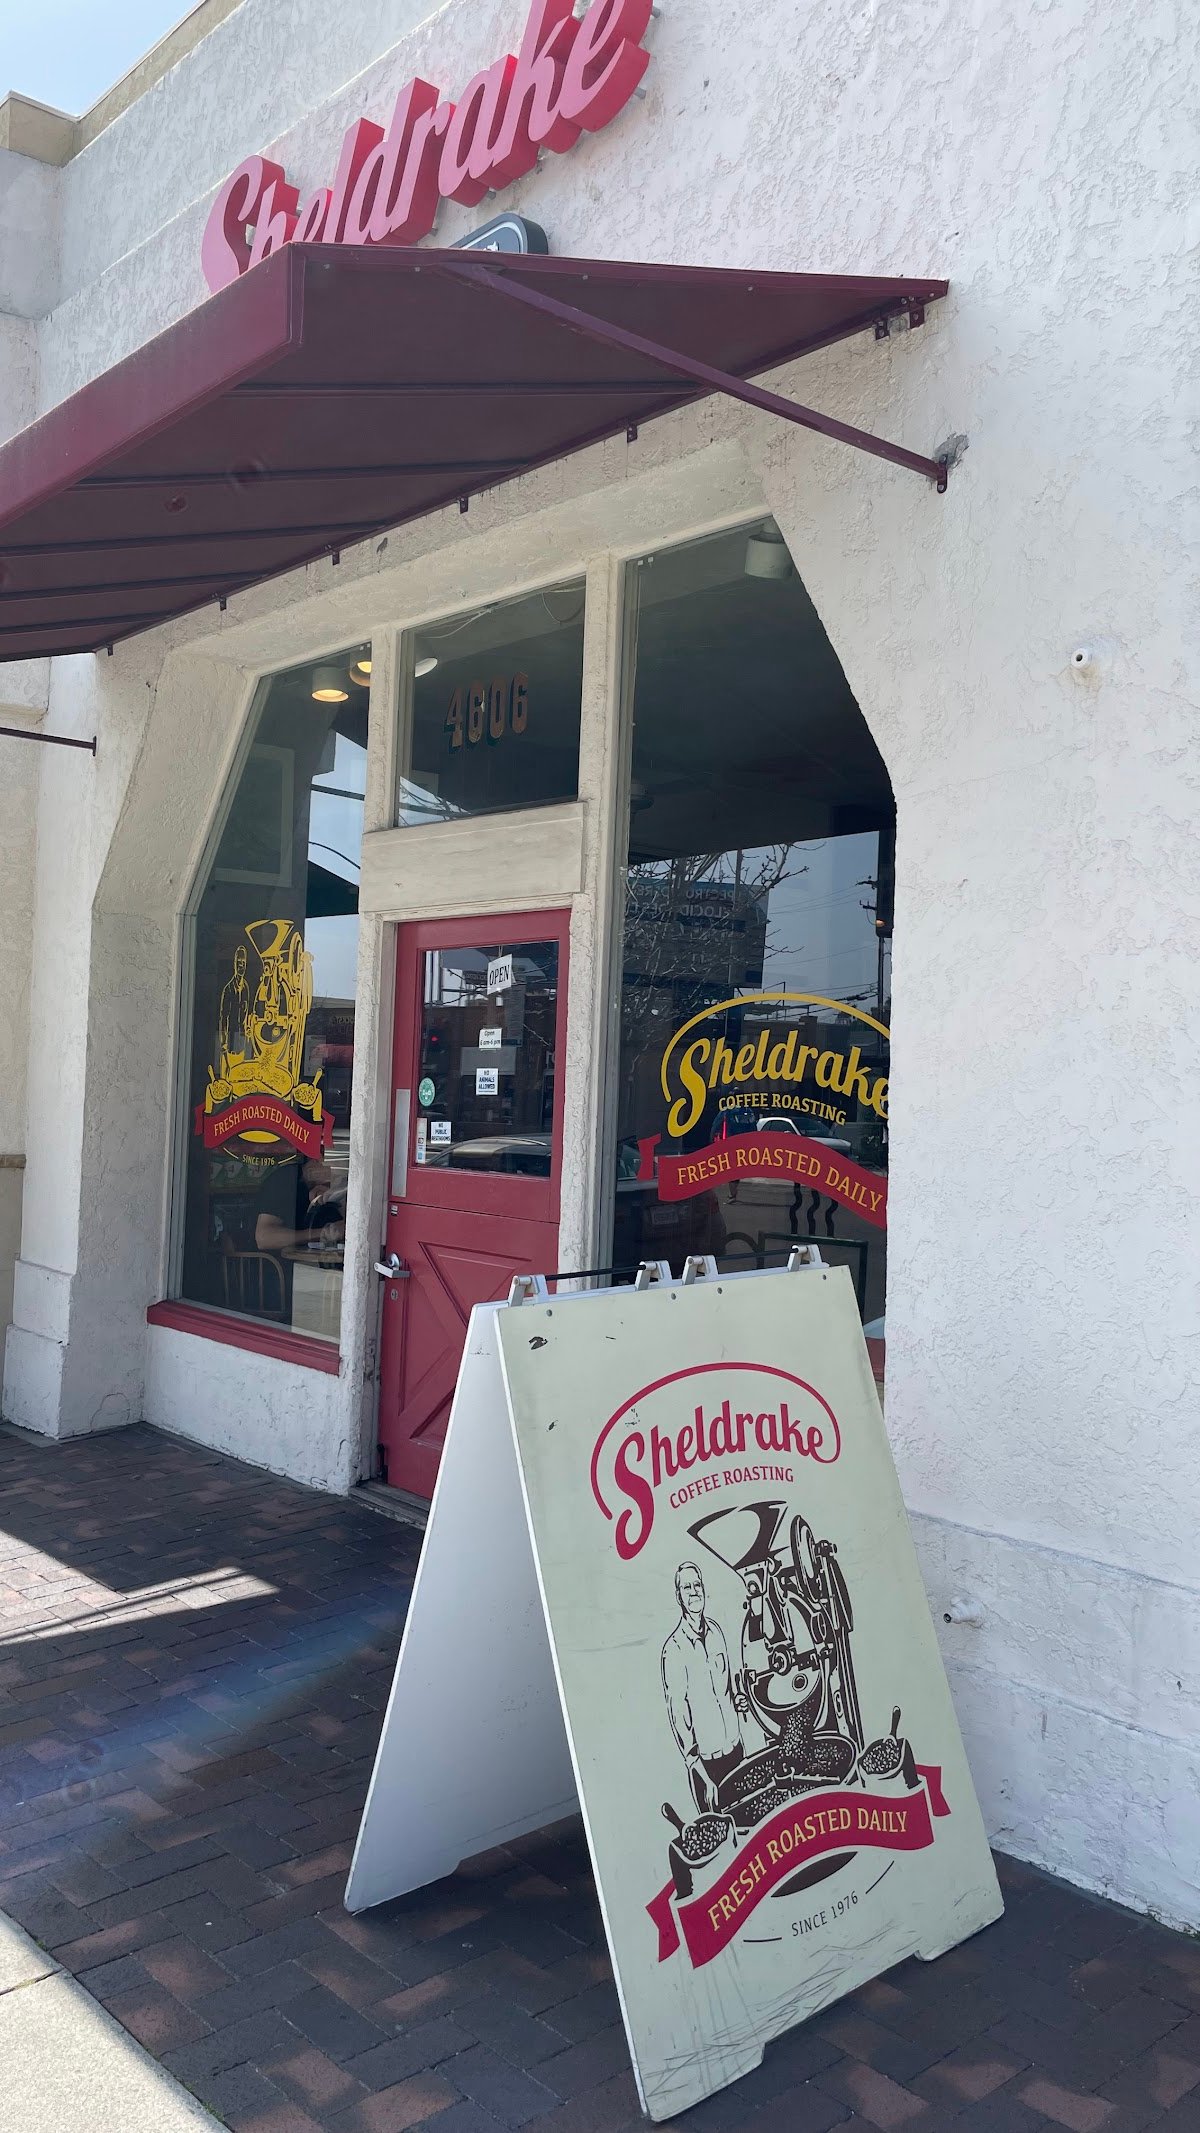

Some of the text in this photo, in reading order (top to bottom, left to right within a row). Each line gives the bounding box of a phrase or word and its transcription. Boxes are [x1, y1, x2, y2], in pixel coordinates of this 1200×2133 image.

[444, 671, 529, 752] 4606
[488, 964, 511, 987] OPEN
[667, 1028, 889, 1138] Sheldrake
[214, 1105, 310, 1144] FRESH ROASTED DAILY
[718, 1092, 847, 1127] COFFEE ROASTING
[242, 1153, 275, 1167] SINCE 1976
[677, 1147, 884, 1213] FRESH ROASTED DAILY
[613, 1399, 824, 1561] Sheldrake
[669, 1464, 795, 1510] COFFEE ROASTING
[707, 1806, 908, 1932] FRESH ROASTED DAILY
[791, 1892, 859, 1937] SINCE 1976
